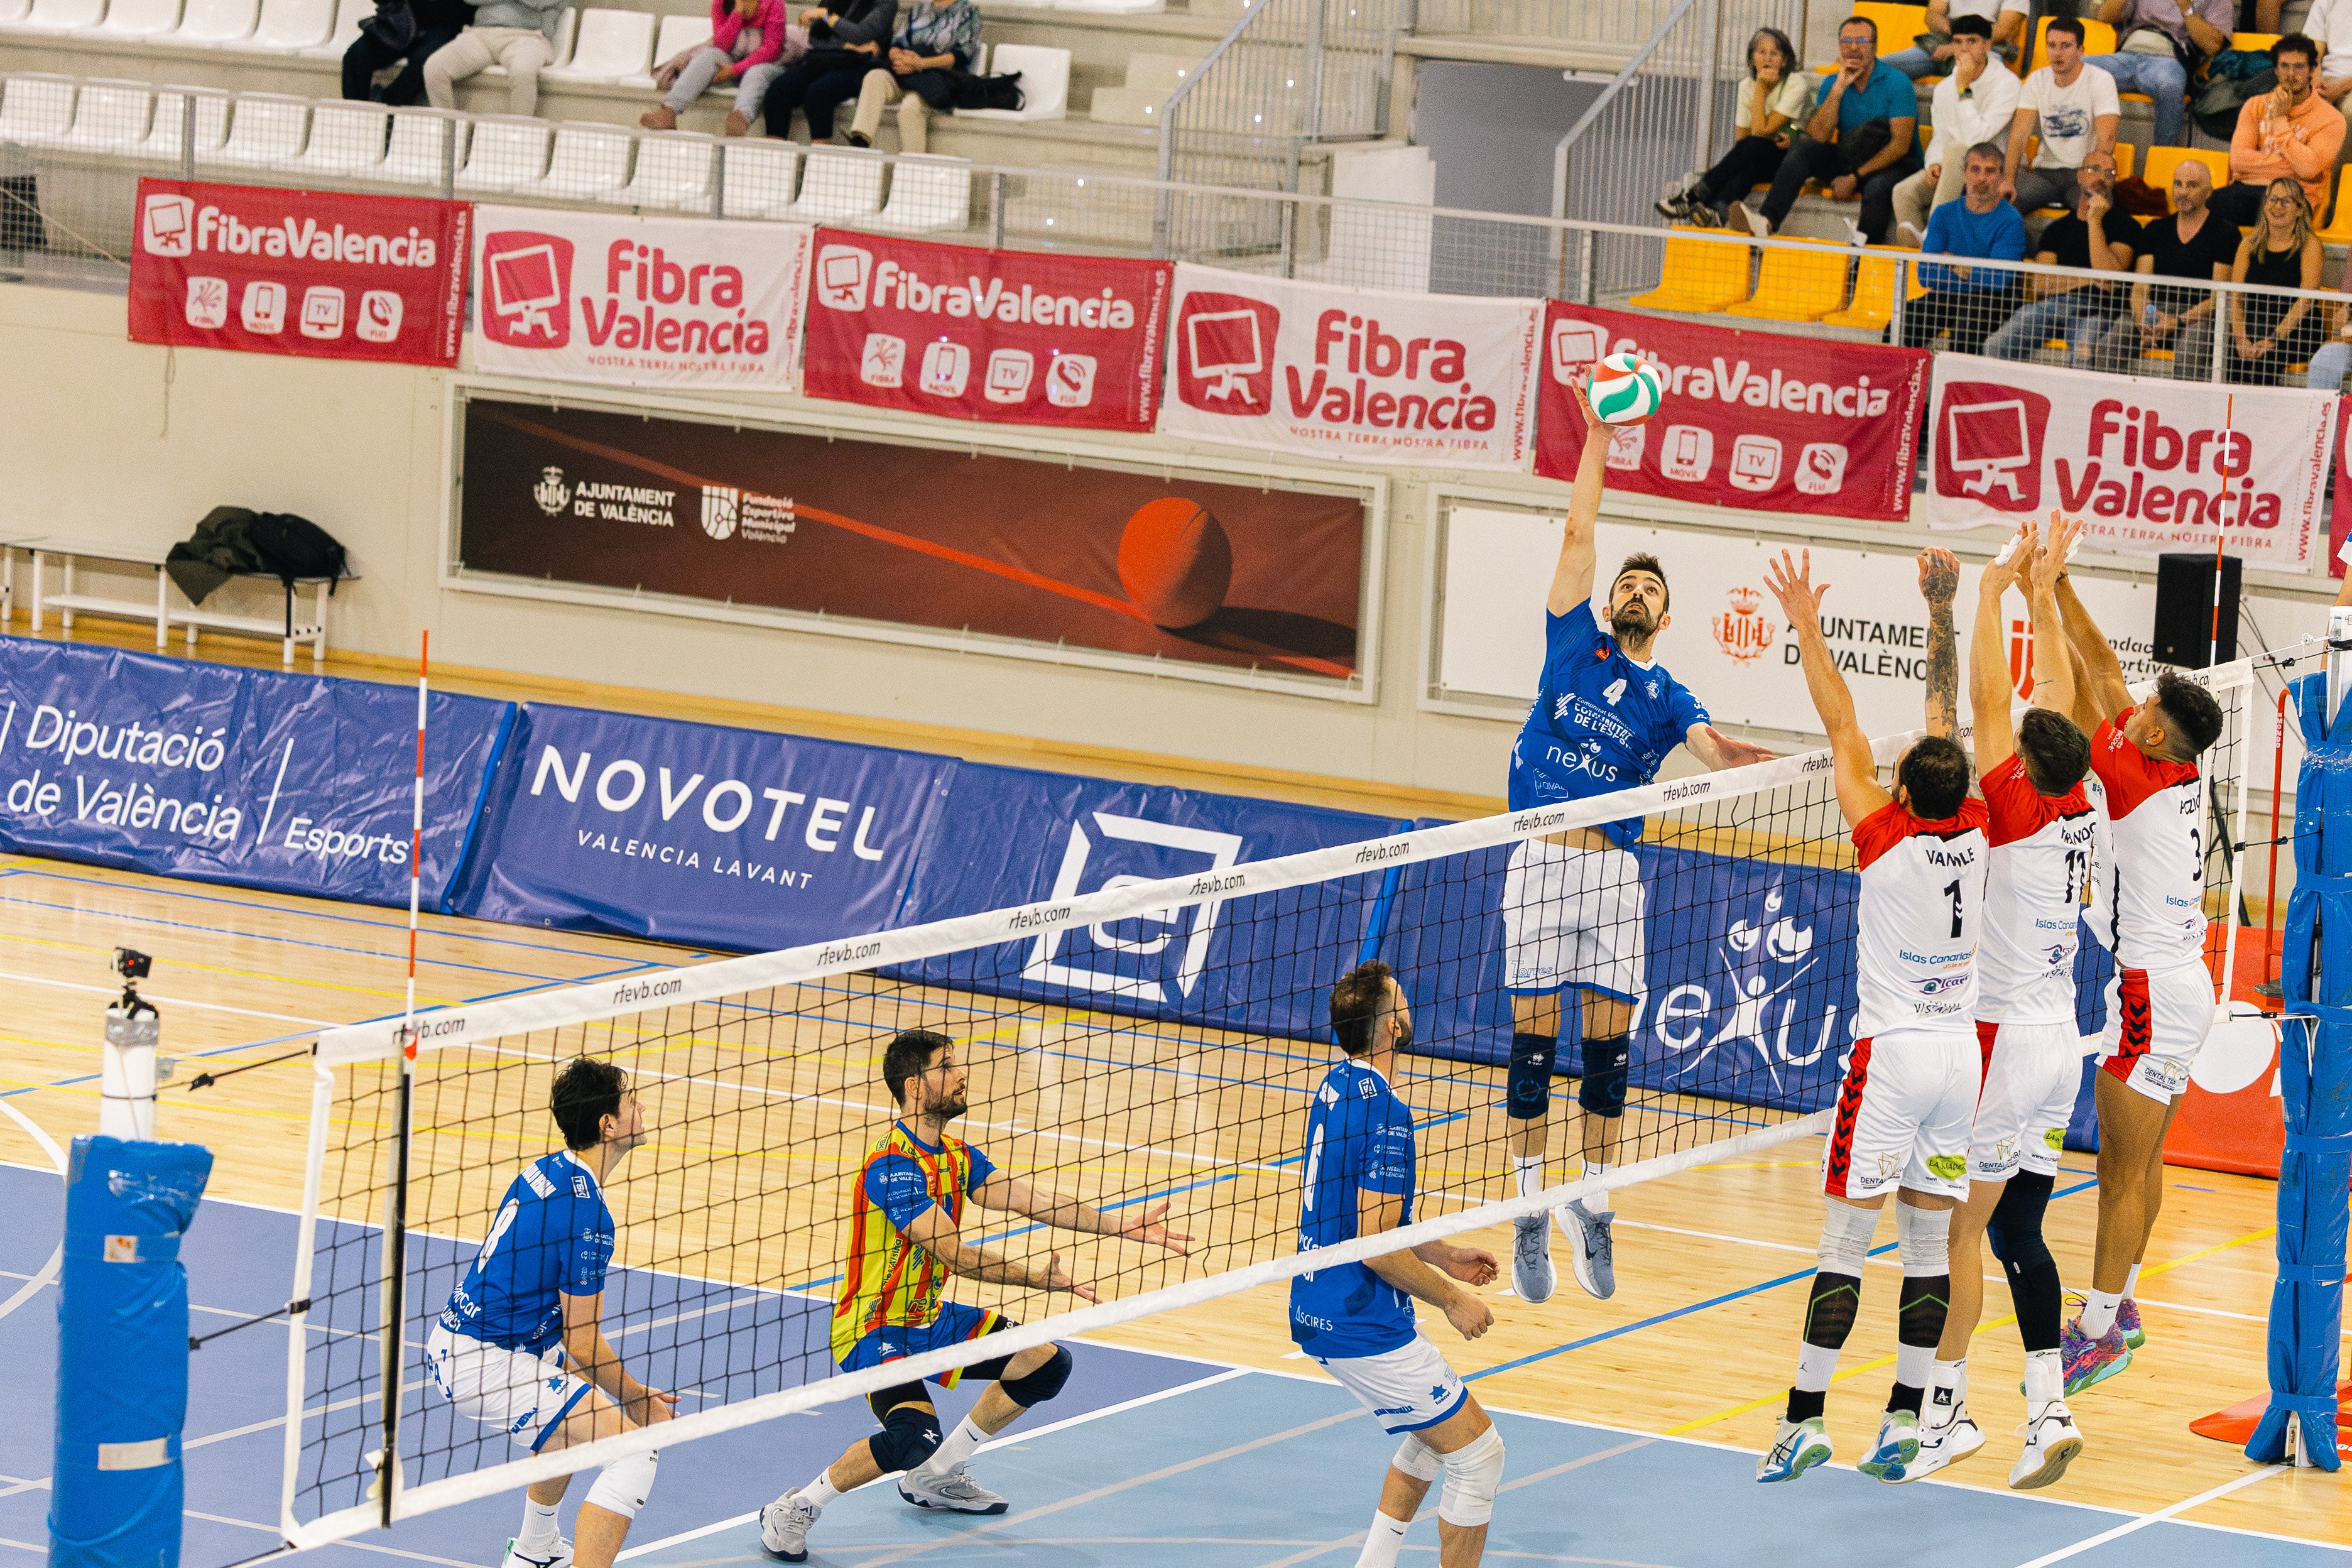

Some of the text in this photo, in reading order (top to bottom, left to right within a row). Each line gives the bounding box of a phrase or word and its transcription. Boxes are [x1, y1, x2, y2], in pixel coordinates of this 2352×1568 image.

[316, 304, 331, 315] TV
[1002, 369, 1018, 379] TV
[1613, 339, 1890, 418] braValencia
[1285, 365, 1496, 432] Valencia
[1290, 426, 1489, 450] NOSTRA TERRA NOSTRA FIBRA
[1747, 454, 1767, 466] TV
[2297, 401, 2332, 561] www.fibravalencia.es
[575, 481, 676, 508] AJUNTAMENT
[2054, 457, 2282, 530] Valencia
[574, 500, 596, 518] DE
[2081, 522, 2116, 536] STRA
[2121, 527, 2165, 542] TERRA
[2231, 536, 2273, 550] FIBRA
[1602, 678, 1628, 707] 4
[1574, 713, 1589, 728] DE
[24, 704, 227, 772] Diputació
[1801, 753, 1835, 774] rfevb.c
[530, 744, 885, 861] NOVOTEL
[1663, 780, 1711, 803] rfevb.com
[7, 770, 242, 841] de València
[1512, 810, 1565, 833] rfevb.com
[284, 817, 410, 864] Esports
[1354, 840, 1410, 864] rfevb.com
[577, 829, 813, 890] VALENCIA LAVANT
[1189, 873, 1246, 896] rfevb.com
[2064, 849, 2086, 903] 11
[1944, 879, 1963, 939] 1
[2166, 895, 2189, 908] Islas
[1008, 906, 1070, 930] rfevb.com
[2035, 917, 2057, 930] Islas
[816, 940, 881, 967] rfevb.com
[1899, 949, 1971, 964] Islas Canarias
[1511, 960, 1554, 976] Torres
[612, 977, 683, 1004] rfevb.com
[2145, 1067, 2167, 1082] DENTAL
[1929, 1159, 1939, 1169] LA
